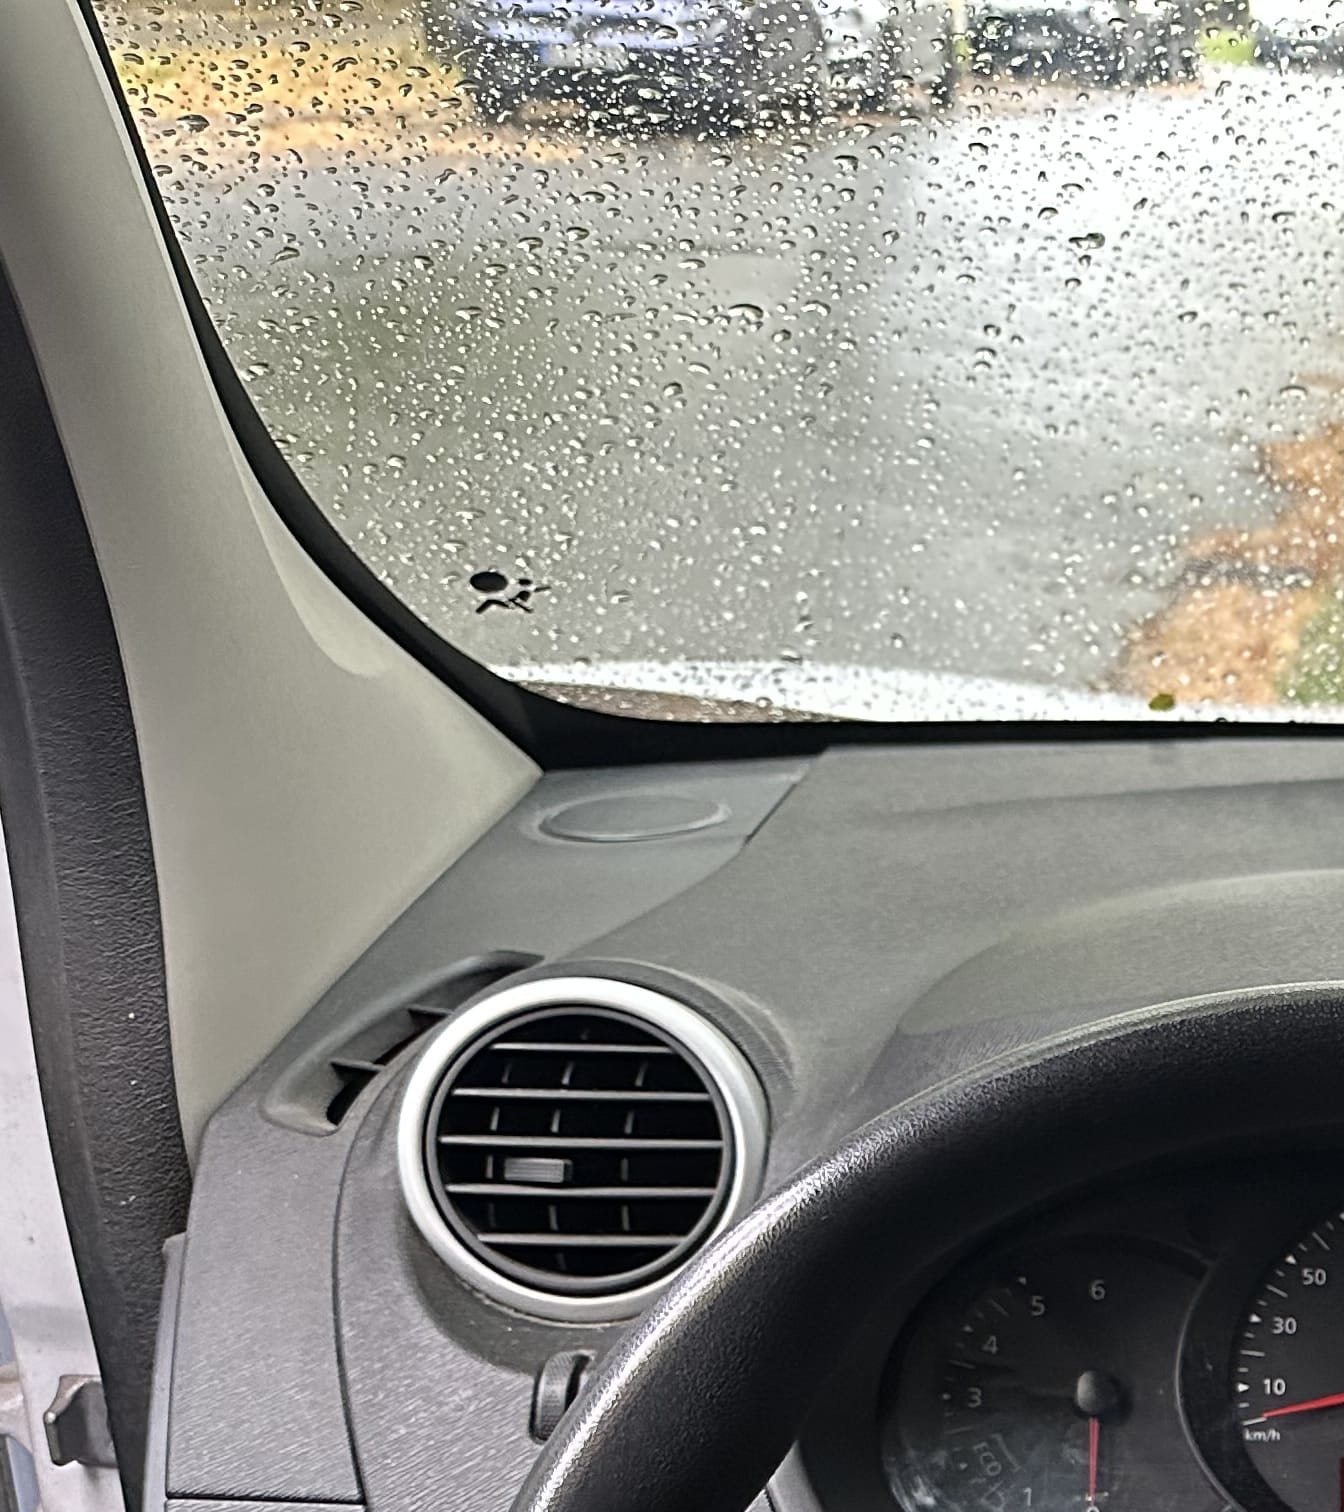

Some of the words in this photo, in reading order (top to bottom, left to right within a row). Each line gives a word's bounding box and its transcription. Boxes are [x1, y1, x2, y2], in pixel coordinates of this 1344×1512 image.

[1302, 1267, 1327, 1286] 50
[1089, 1280, 1107, 1300] 6
[1030, 1295, 1046, 1316] 5
[1272, 1317, 1297, 1335] 30
[981, 1335, 999, 1354] 4
[1263, 1378, 1286, 1395] 10
[967, 1387, 982, 1408] 3
[1244, 1428, 1281, 1441] km/h
[973, 1441, 1003, 1477] ECO
[1023, 1487, 1033, 1507] 1
